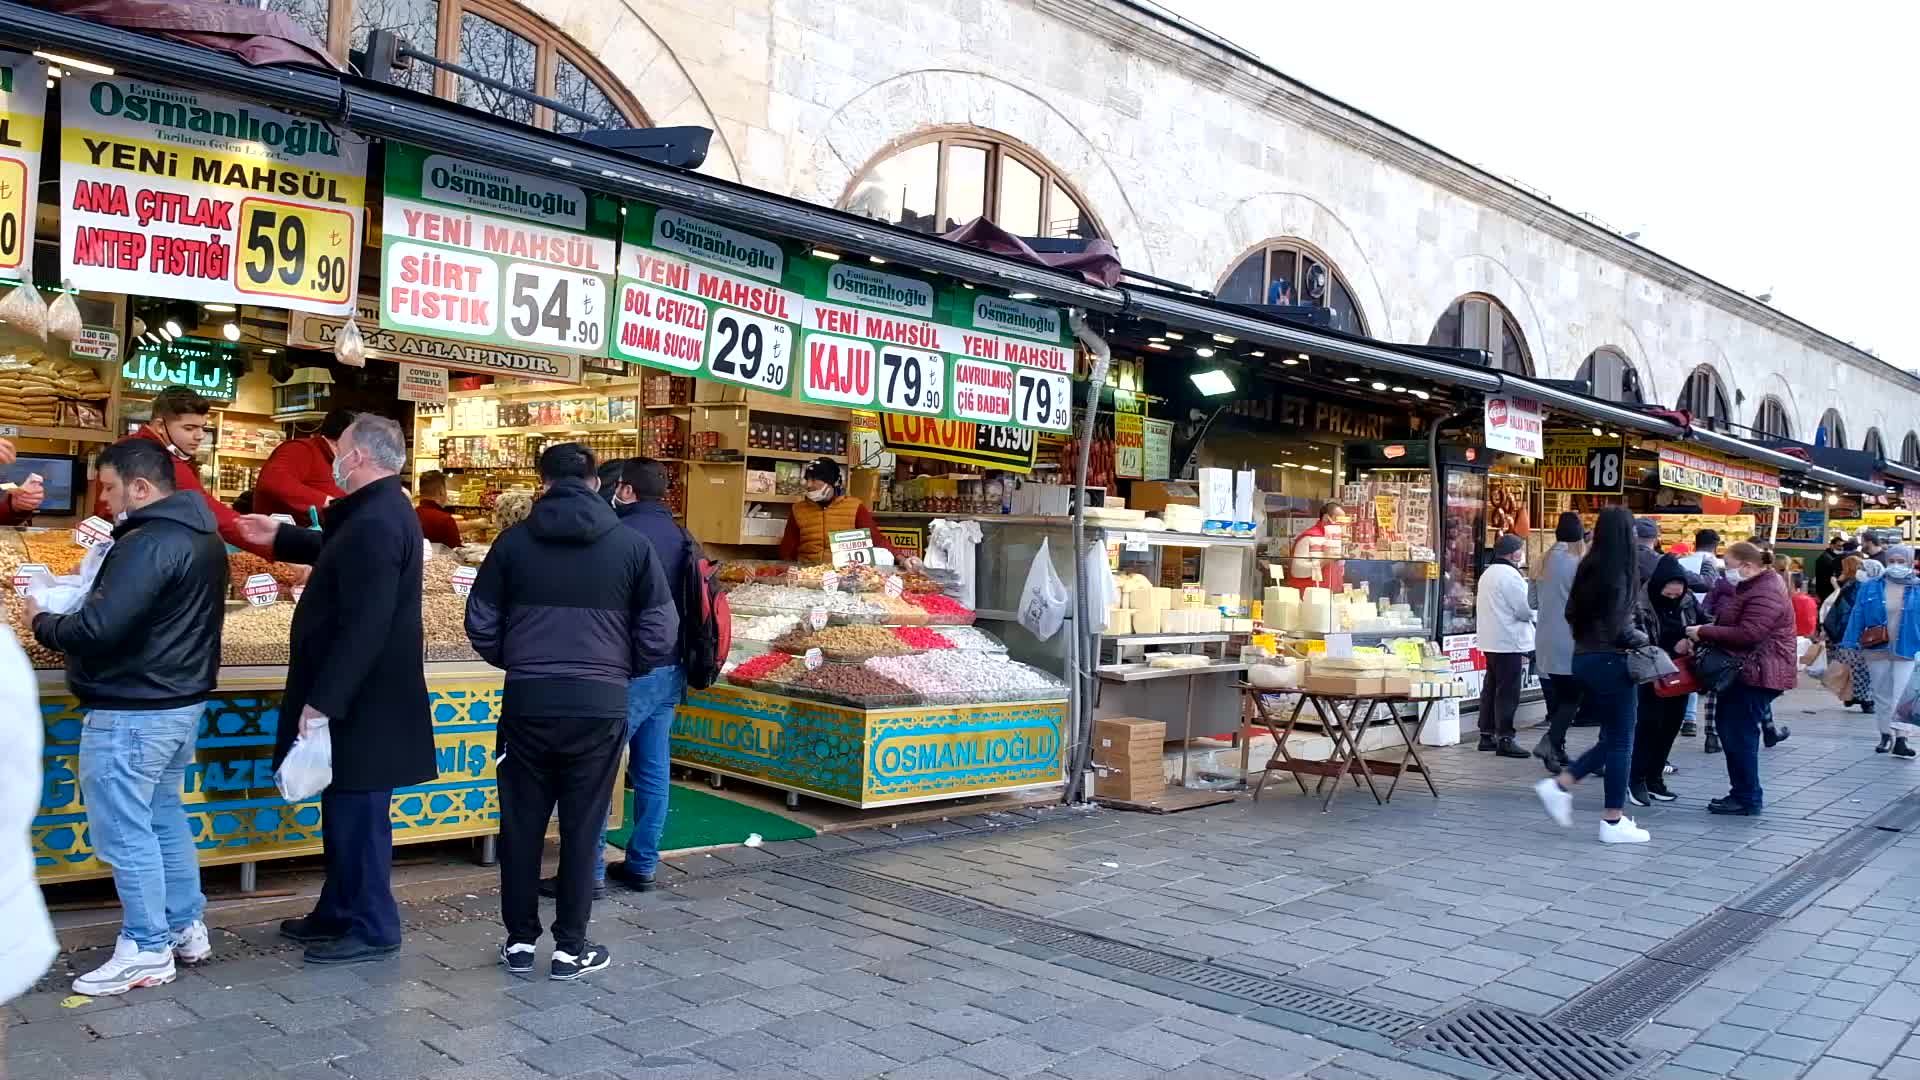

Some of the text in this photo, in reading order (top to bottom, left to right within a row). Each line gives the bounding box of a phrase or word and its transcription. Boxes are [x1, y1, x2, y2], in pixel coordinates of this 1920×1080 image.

[89, 81, 339, 157] Osmanlıoğlu
[192, 156, 348, 204] MAHSÜL
[430, 167, 577, 217] Osmanlıoğlu
[72, 180, 234, 232] ANA ÇITLAK
[72, 226, 231, 282] ANTEP FISTIĞI
[401, 207, 473, 248] YENİ
[483, 223, 599, 270] MAHSÜL
[660, 218, 775, 271] Osmanlıoğlu
[400, 252, 483, 294] SİİRT
[582, 276, 596, 287] KG
[635, 254, 690, 292] YENİ
[697, 272, 789, 320] MAHSÜL
[833, 272, 927, 307] Osmanlıoğlu
[391, 285, 491, 327] FISTIK
[624, 287, 651, 318] BOL
[978, 303, 1055, 333] Osmanlıoğlu
[620, 321, 703, 363] ADANA SUCUK
[773, 324, 785, 334] KG
[815, 306, 941, 349] YENİ MAHSÜL
[809, 341, 872, 397] KAJU
[963, 334, 999, 360] YENİ
[1004, 343, 1068, 372] MAHSÜL
[956, 363, 1014, 396] KAVRULMUŞ
[957, 388, 1010, 417] ÇİĞ BADEM
[1589, 452, 1620, 487] 18
[881, 732, 1053, 772] OSMANLIOĞLU
